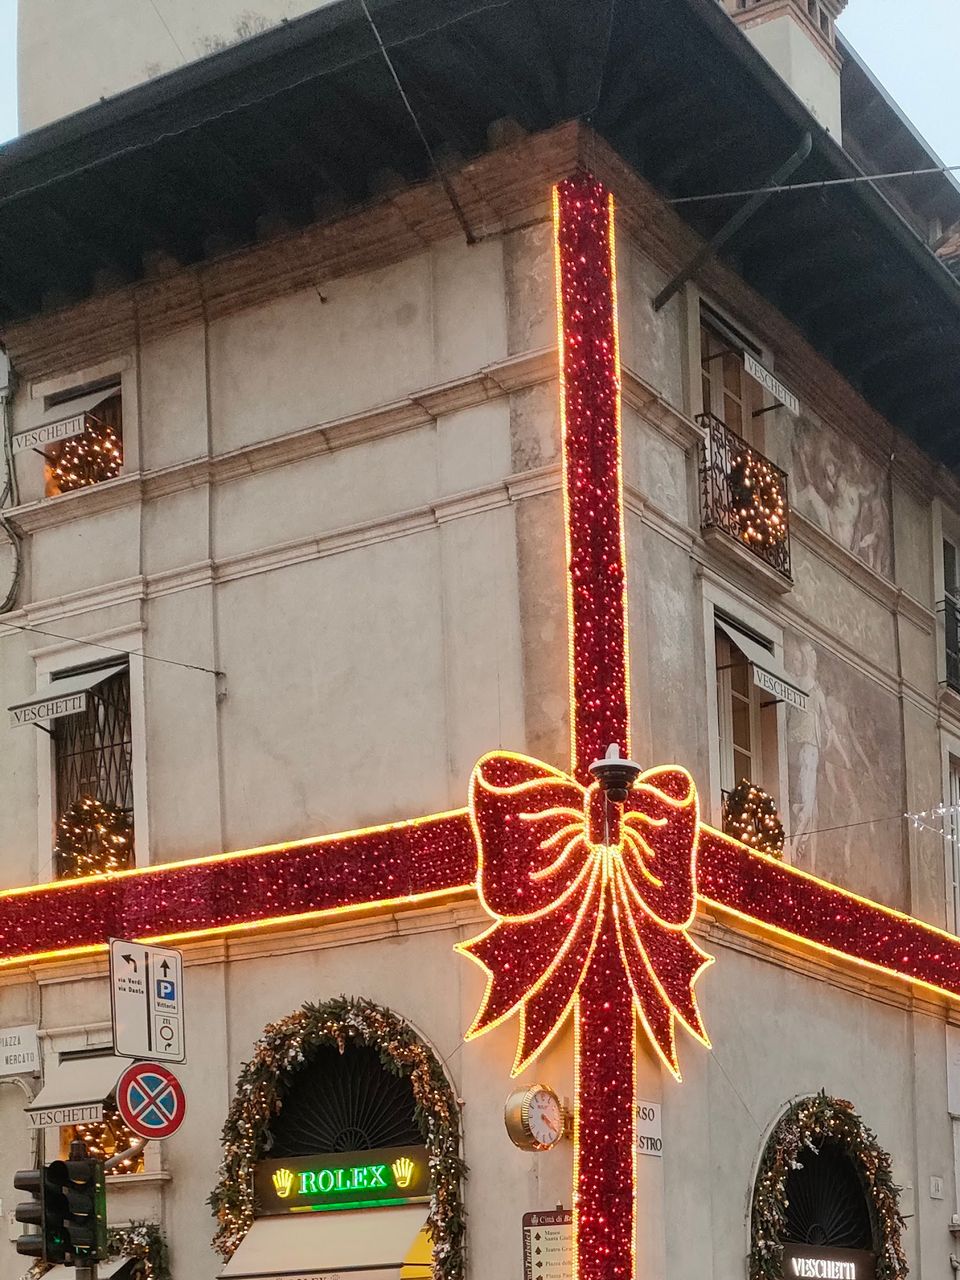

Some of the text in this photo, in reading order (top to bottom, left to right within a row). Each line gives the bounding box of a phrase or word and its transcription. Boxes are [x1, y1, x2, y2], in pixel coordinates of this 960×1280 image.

[747, 356, 797, 411] VESCHETTI
[15, 418, 81, 448] VESCHETTI
[756, 669, 806, 709] VESCHETTI
[14, 695, 82, 723] VESCHETTI
[30, 1106, 100, 1126] VESCHETTI
[636, 1106, 655, 1121] RSO
[636, 1134, 663, 1152] STRO
[297, 1165, 388, 1195] ROLEX
[791, 1257, 856, 1280] VESCHETTI
